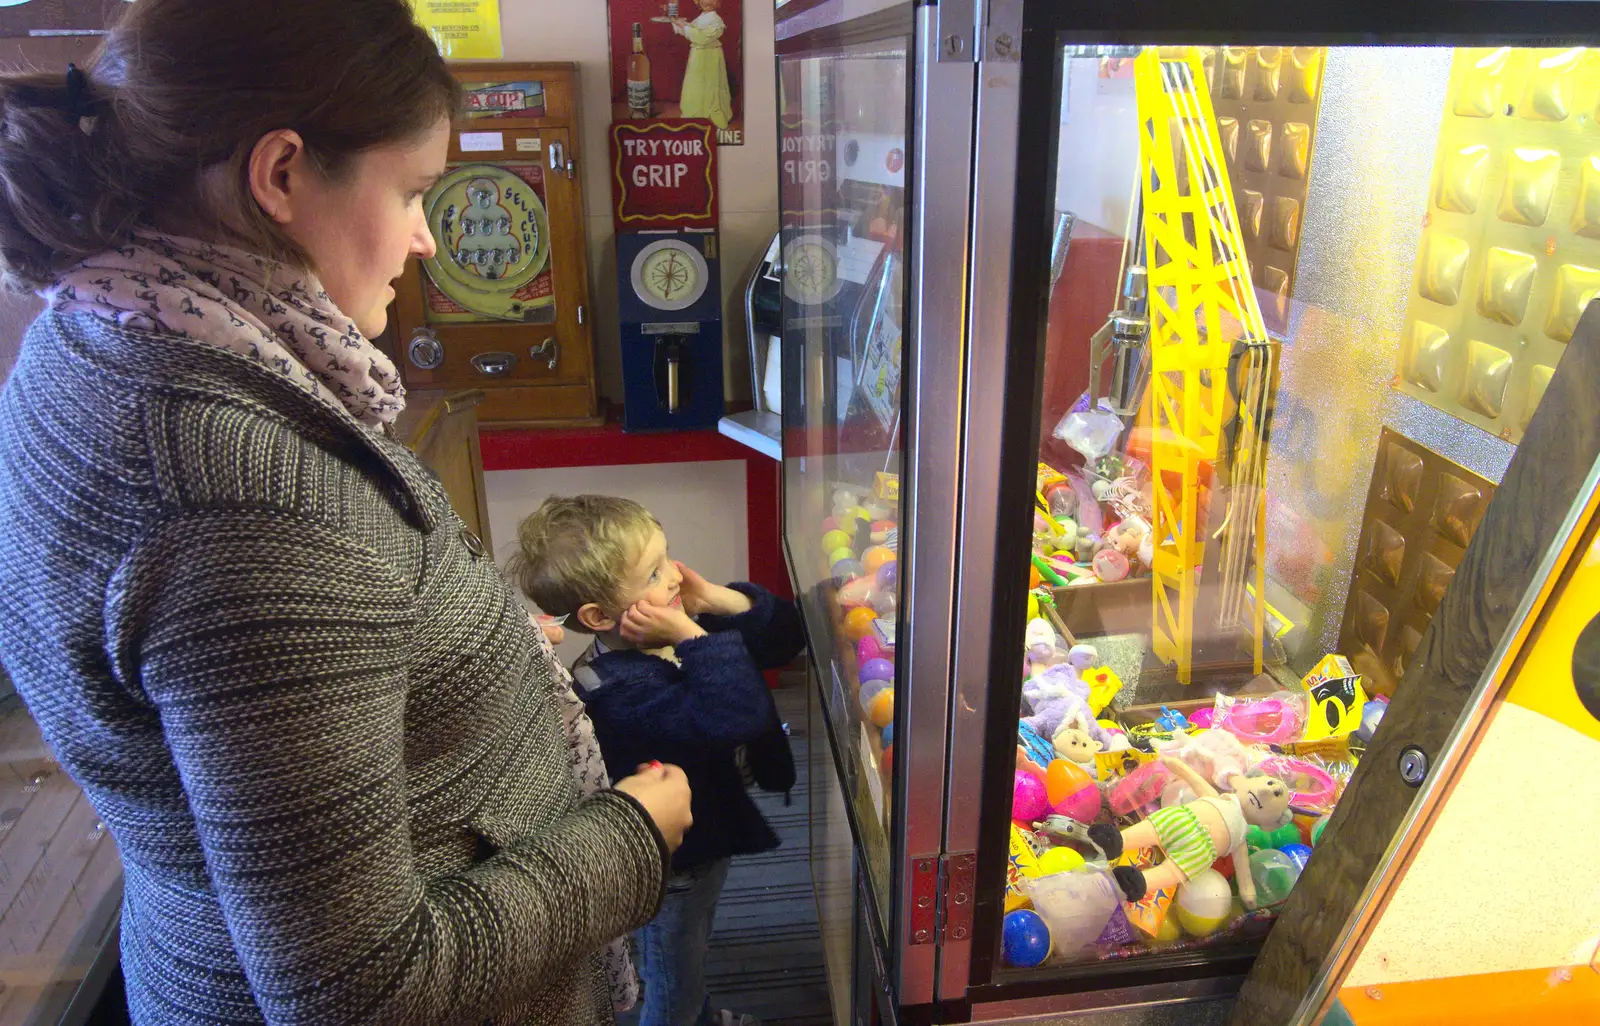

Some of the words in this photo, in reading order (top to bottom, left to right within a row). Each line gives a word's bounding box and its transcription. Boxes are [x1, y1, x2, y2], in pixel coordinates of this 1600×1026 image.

[486, 92, 518, 106] CUP
[717, 130, 742, 144] INE
[624, 139, 661, 156] TRY
[662, 139, 704, 156] YOUR
[632, 162, 689, 188] GRIP
[520, 220, 531, 256] CUP
